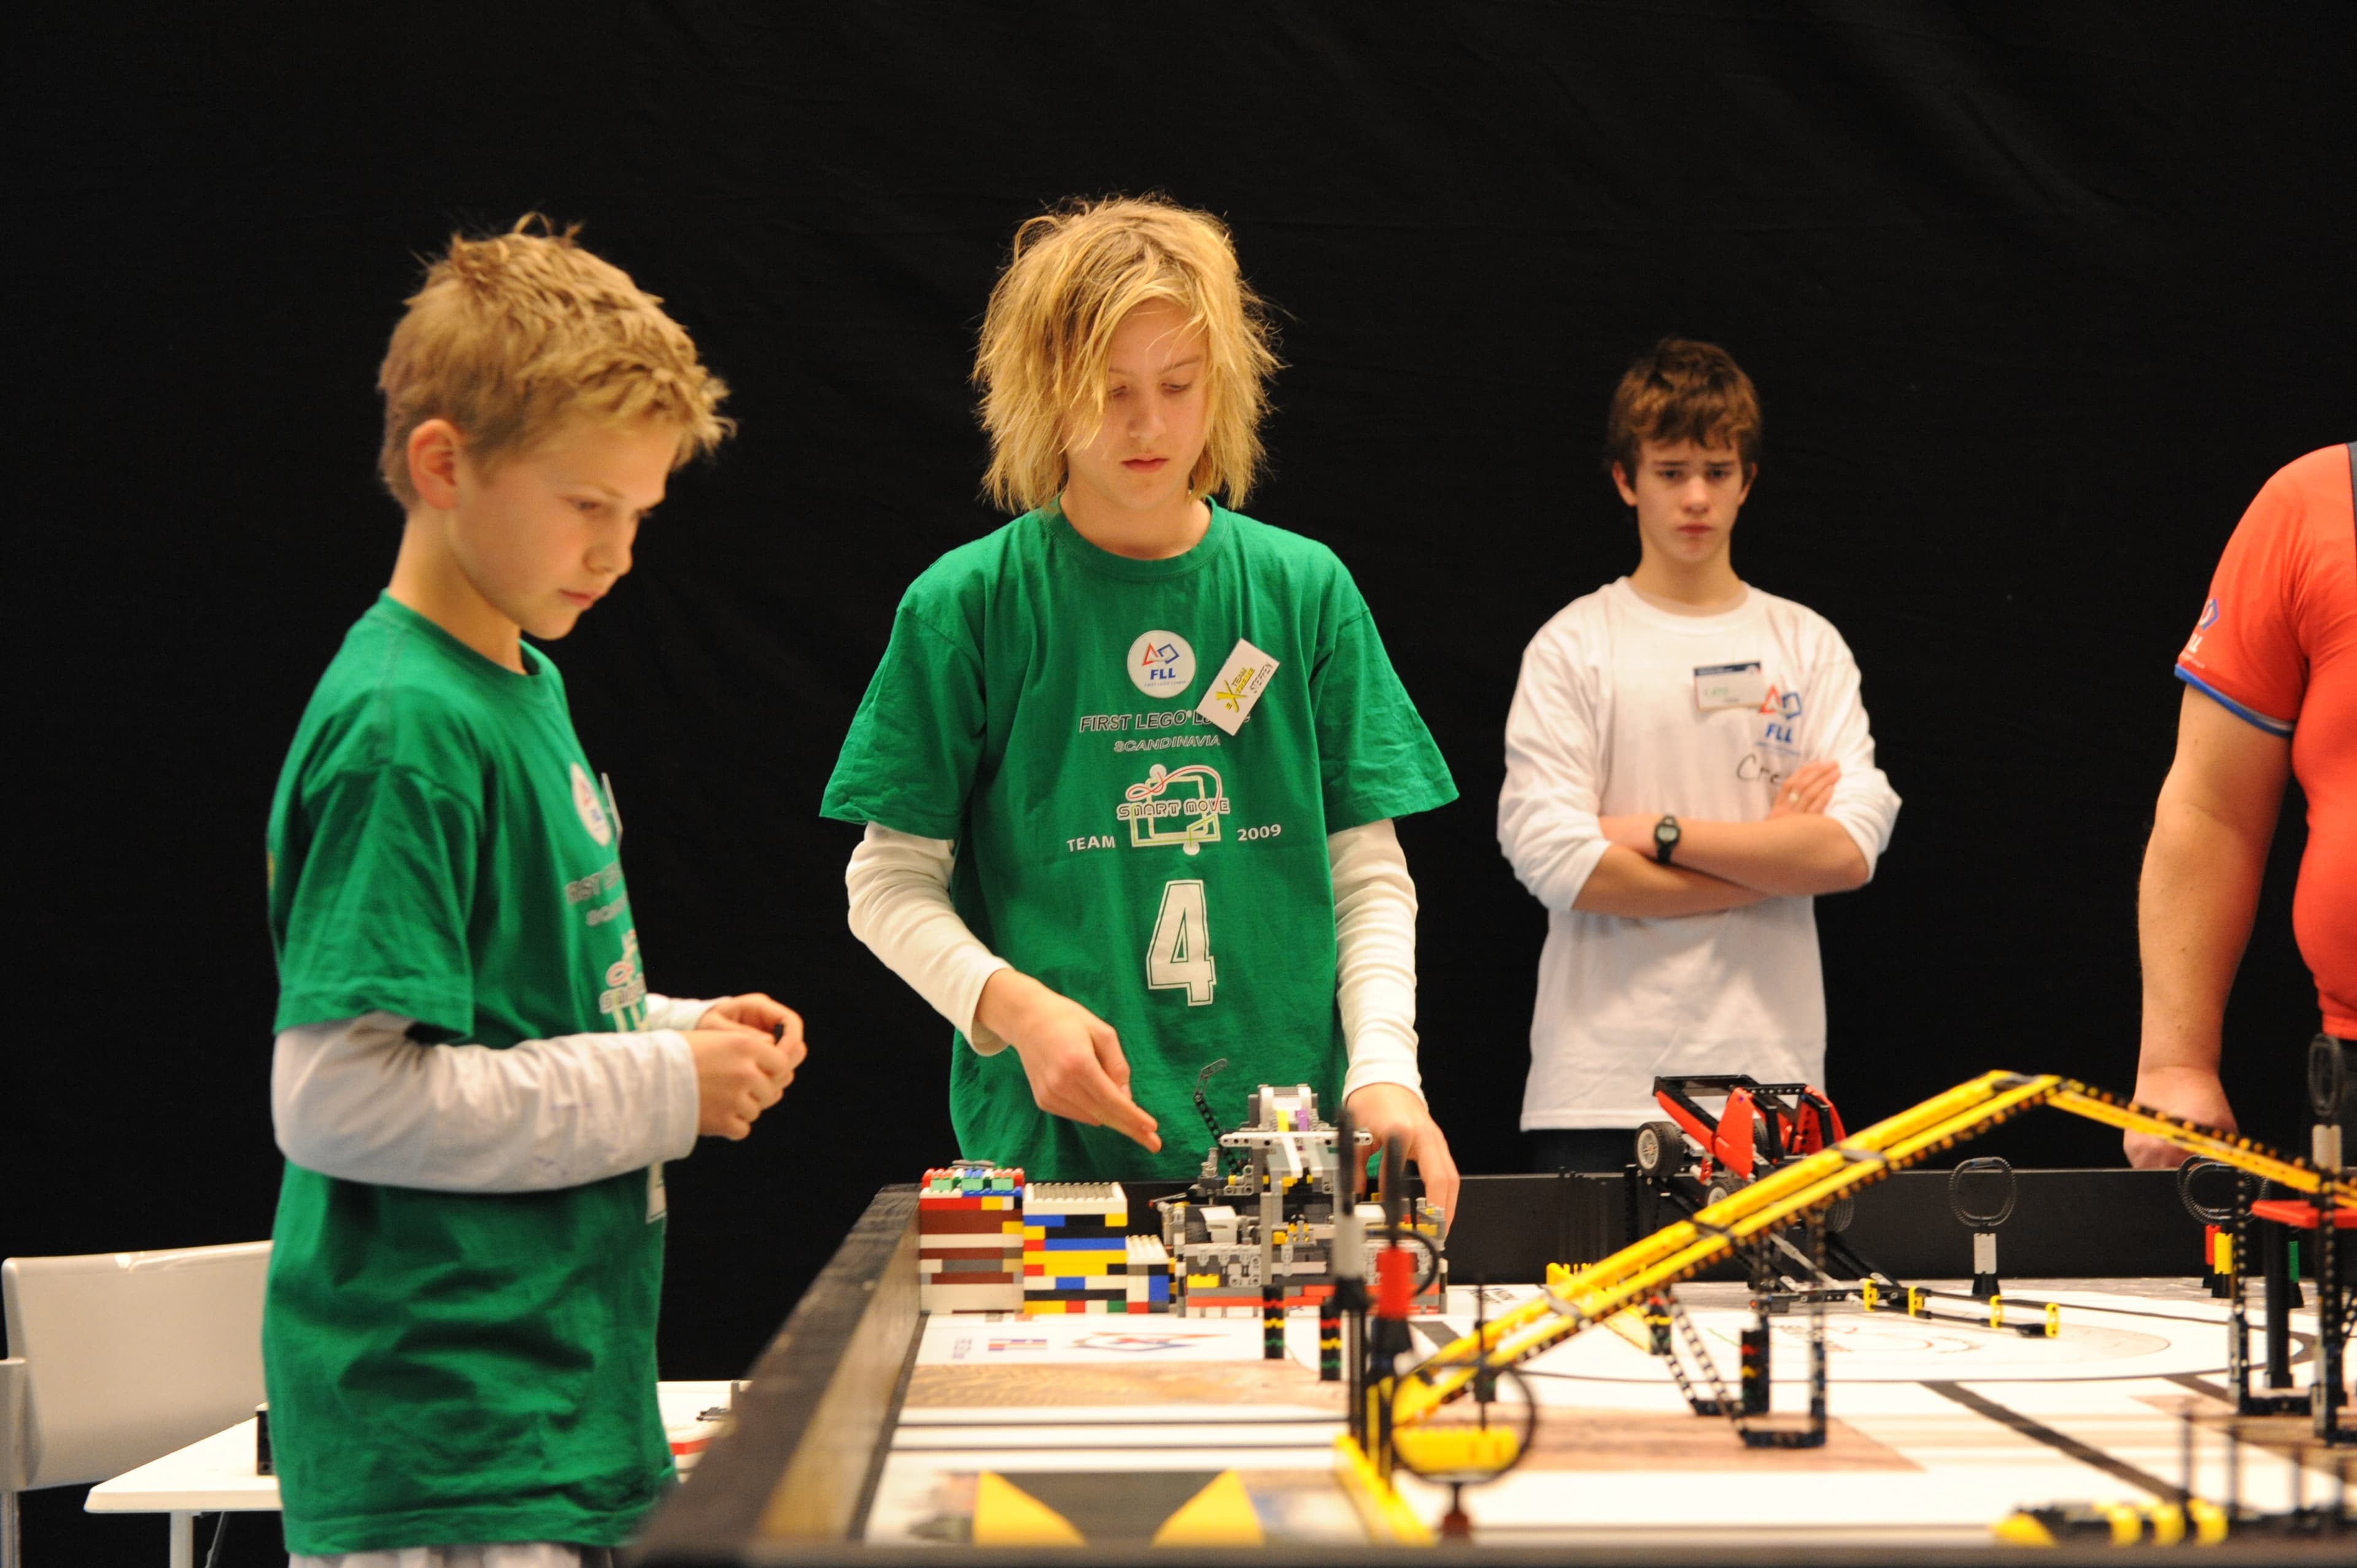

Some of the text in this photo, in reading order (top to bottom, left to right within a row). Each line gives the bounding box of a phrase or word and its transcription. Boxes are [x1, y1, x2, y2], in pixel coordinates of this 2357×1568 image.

[1150, 667, 1176, 680] FLL
[1231, 667, 1247, 687] TEAM
[1079, 714, 1132, 733] FIRST
[1765, 724, 1792, 743] FLL
[1113, 735, 1221, 752] SCANDINAVIA
[1736, 753, 1780, 785] Cre
[1117, 798, 1230, 821] SMART MOVE
[1237, 824, 1282, 841] 2009
[1066, 835, 1116, 852] TEAM
[1146, 879, 1217, 1006] 4
